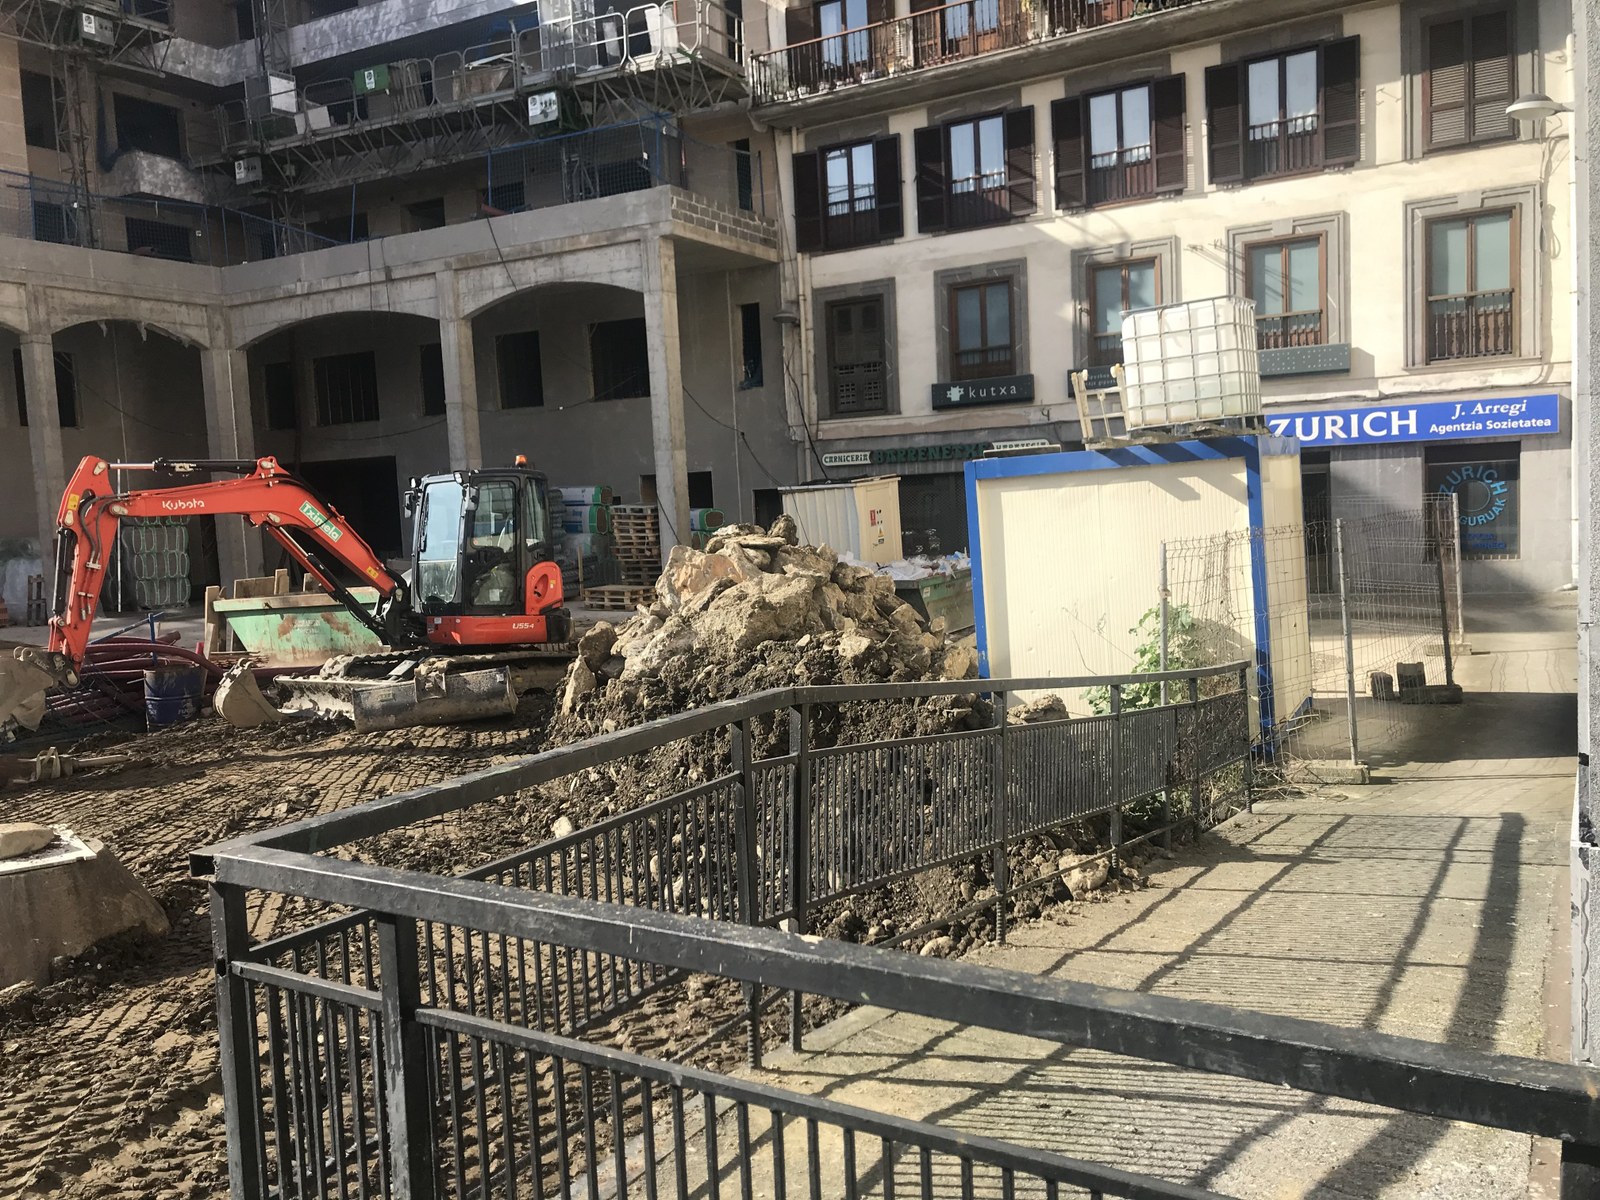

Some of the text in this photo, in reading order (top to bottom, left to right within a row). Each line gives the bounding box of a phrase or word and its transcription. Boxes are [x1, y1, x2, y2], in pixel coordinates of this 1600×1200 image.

[969, 386, 1017, 398] kutxa
[1451, 400, 1528, 419] J. Arregi
[1268, 409, 1418, 441] ZURICH
[1430, 417, 1552, 434] Agentzia Sozietatea
[1440, 465, 1508, 496] ZURICH
[162, 499, 205, 510] Kubota
[1459, 498, 1507, 526] GURUAK
